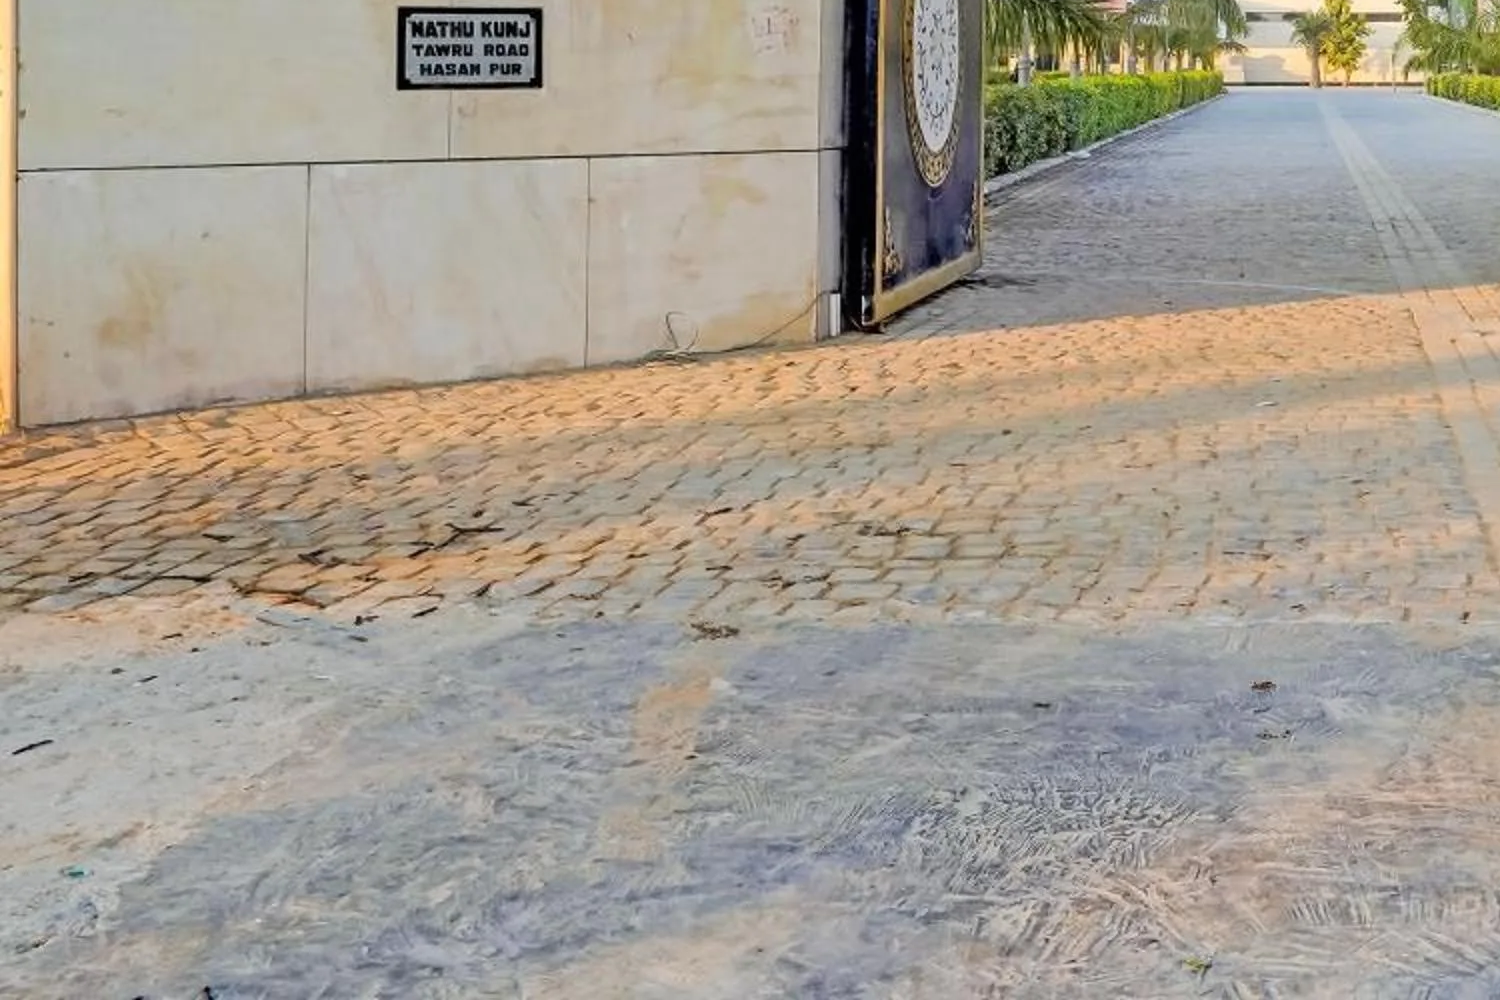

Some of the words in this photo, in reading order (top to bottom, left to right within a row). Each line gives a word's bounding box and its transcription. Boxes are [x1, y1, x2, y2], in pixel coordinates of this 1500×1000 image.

[411, 21, 475, 38] NATHU
[481, 21, 531, 38] KUNJ
[412, 44, 473, 57] TAWRU
[484, 44, 529, 57] ROAD
[420, 63, 481, 76] HASAN
[489, 63, 522, 75] PUR
